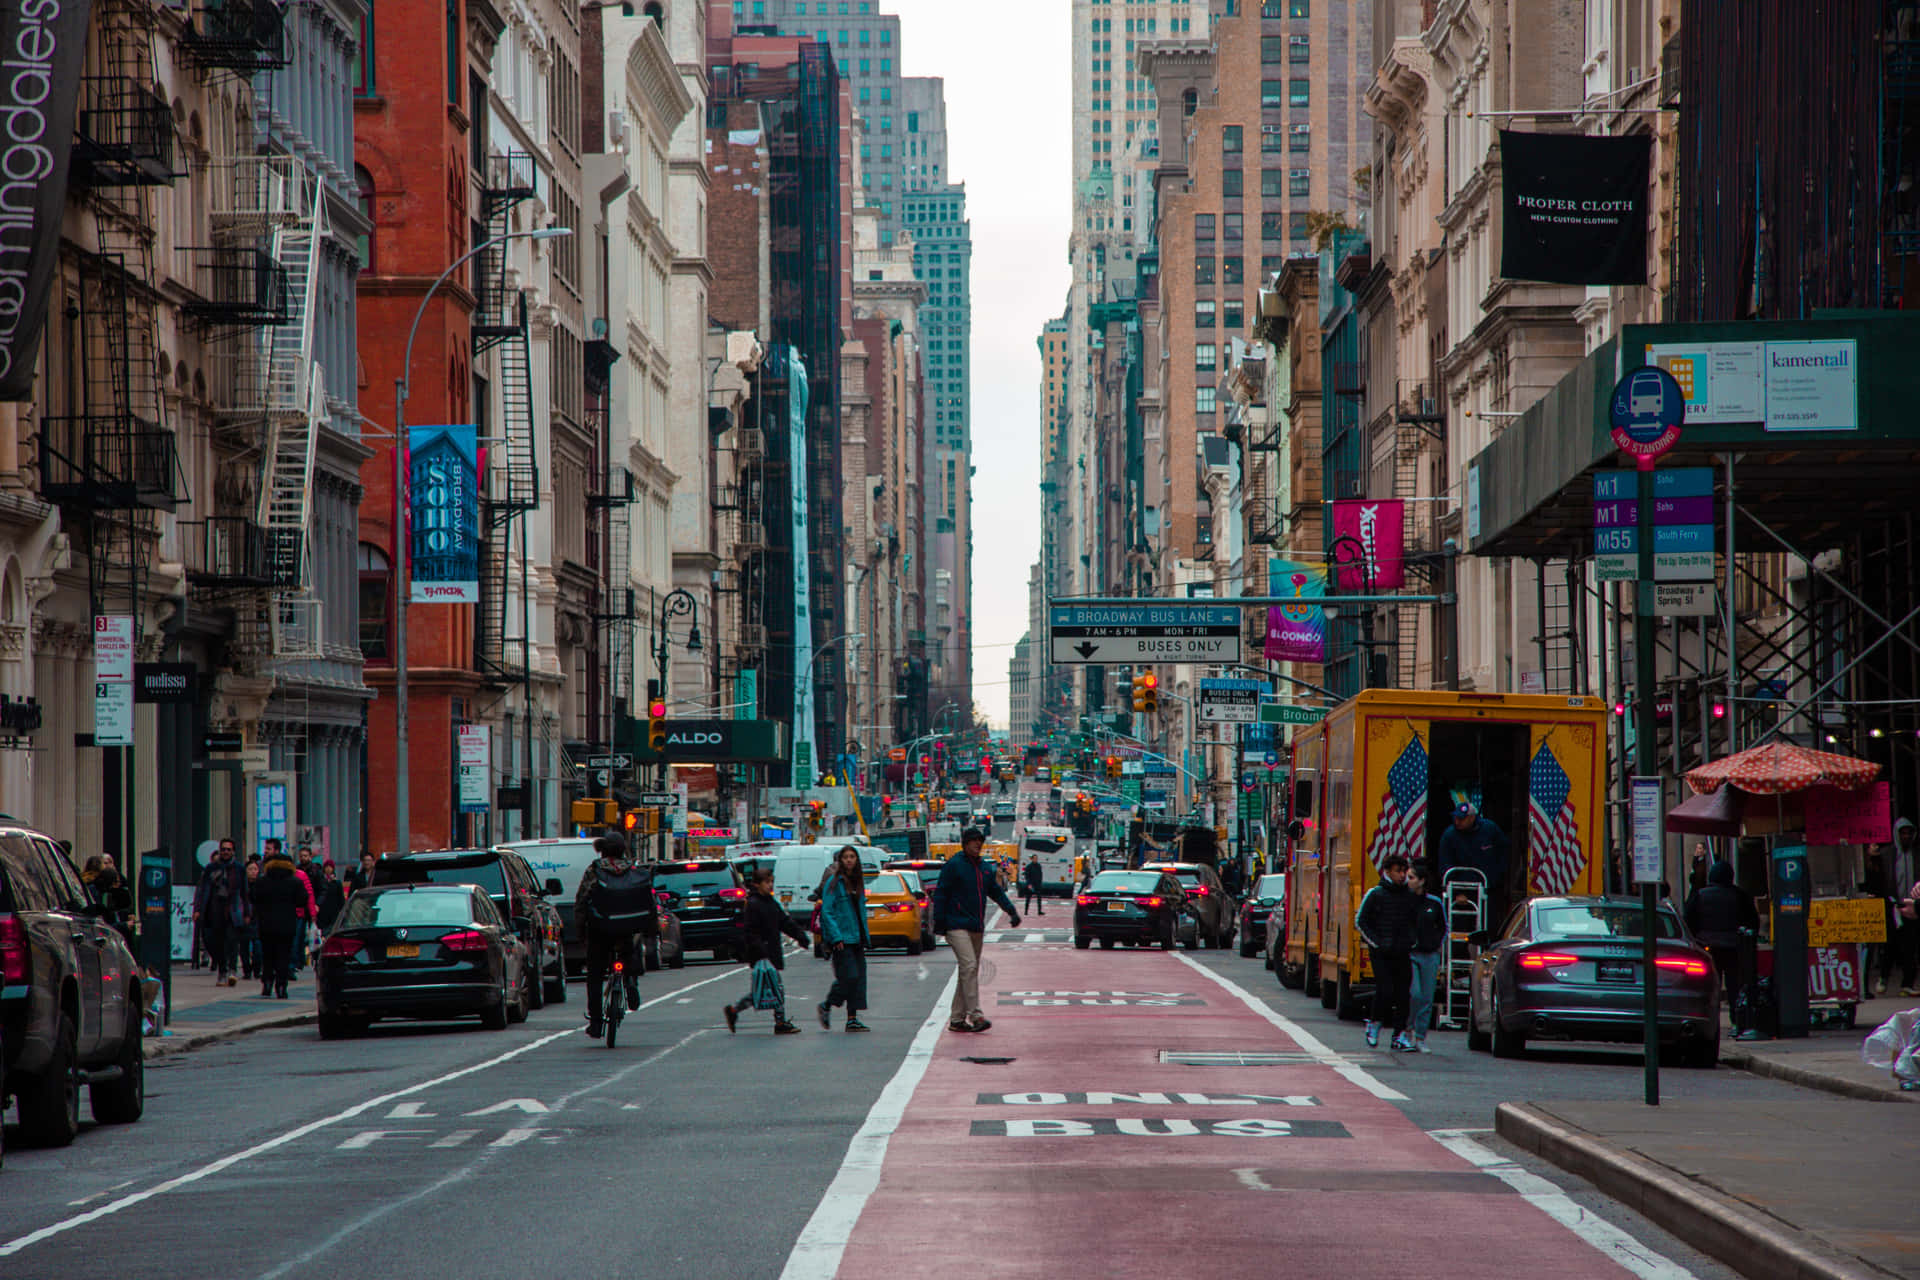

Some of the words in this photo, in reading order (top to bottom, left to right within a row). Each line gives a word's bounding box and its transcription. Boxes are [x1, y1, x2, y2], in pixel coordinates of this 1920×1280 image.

[1517, 195, 1577, 211] PROPER
[1581, 200, 1633, 212] CLOTH
[1530, 214, 1551, 223] MEN'S
[1553, 216, 1582, 224] CUSTOM
[1583, 216, 1619, 225] CLOTHING
[1772, 349, 1848, 368] kamentall
[1617, 433, 1630, 448] NO
[1631, 430, 1675, 454] STANDING
[1596, 477, 1618, 497] M1
[453, 464, 463, 550] BROADWAY
[1597, 503, 1618, 524] M1
[1597, 529, 1632, 551] M55
[1657, 530, 1678, 541] South
[1679, 529, 1698, 542] Ferry
[1657, 585, 1694, 596] Broadway
[1698, 586, 1705, 594] &
[1657, 596, 1682, 607] Spring
[1685, 595, 1694, 605] St
[1077, 611, 1144, 623] BROADWAY
[1150, 610, 1175, 622] BUS
[1180, 610, 1215, 622] LANE
[97, 618, 105, 630] 3
[1085, 628, 1091, 636] 7
[1093, 628, 1107, 636] AM
[1124, 628, 1137, 636] PM
[1164, 628, 1184, 636] MON
[1193, 627, 1208, 636] FRI
[1137, 640, 1182, 653] BUSES
[1188, 640, 1222, 652] ONLY
[145, 672, 186, 689] melissa
[97, 684, 105, 697] 2
[1283, 709, 1326, 721] Broome
[667, 732, 722, 744] ALDO
[1785, 861, 1798, 879] P
[1002, 1092, 1319, 1106] ONLY
[1006, 1118, 1294, 1138] BUS
